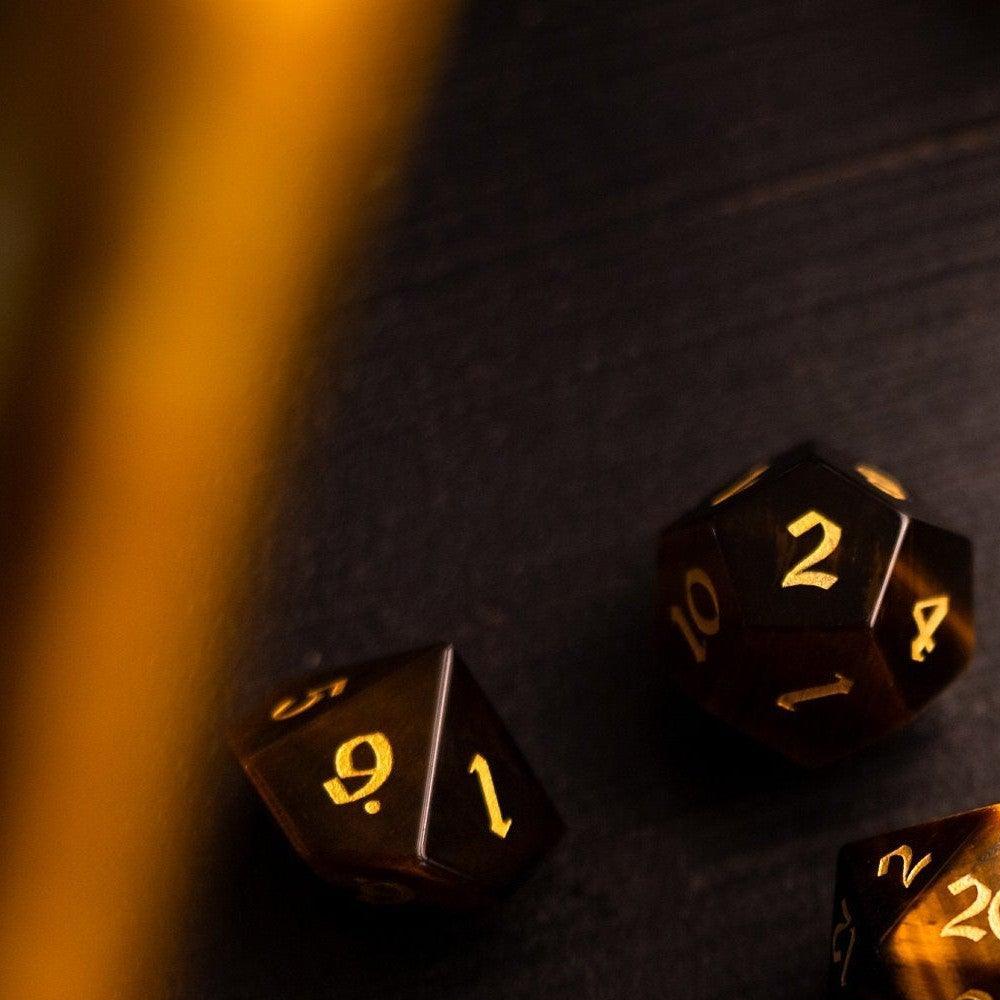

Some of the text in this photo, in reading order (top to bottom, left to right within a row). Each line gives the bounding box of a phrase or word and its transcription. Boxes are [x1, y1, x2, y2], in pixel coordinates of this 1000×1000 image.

[781, 509, 842, 590] 2
[669, 566, 720, 664] 10
[910, 595, 950, 662] 4
[776, 671, 855, 711] 1
[468, 751, 513, 839] 1
[877, 844, 933, 889] 2
